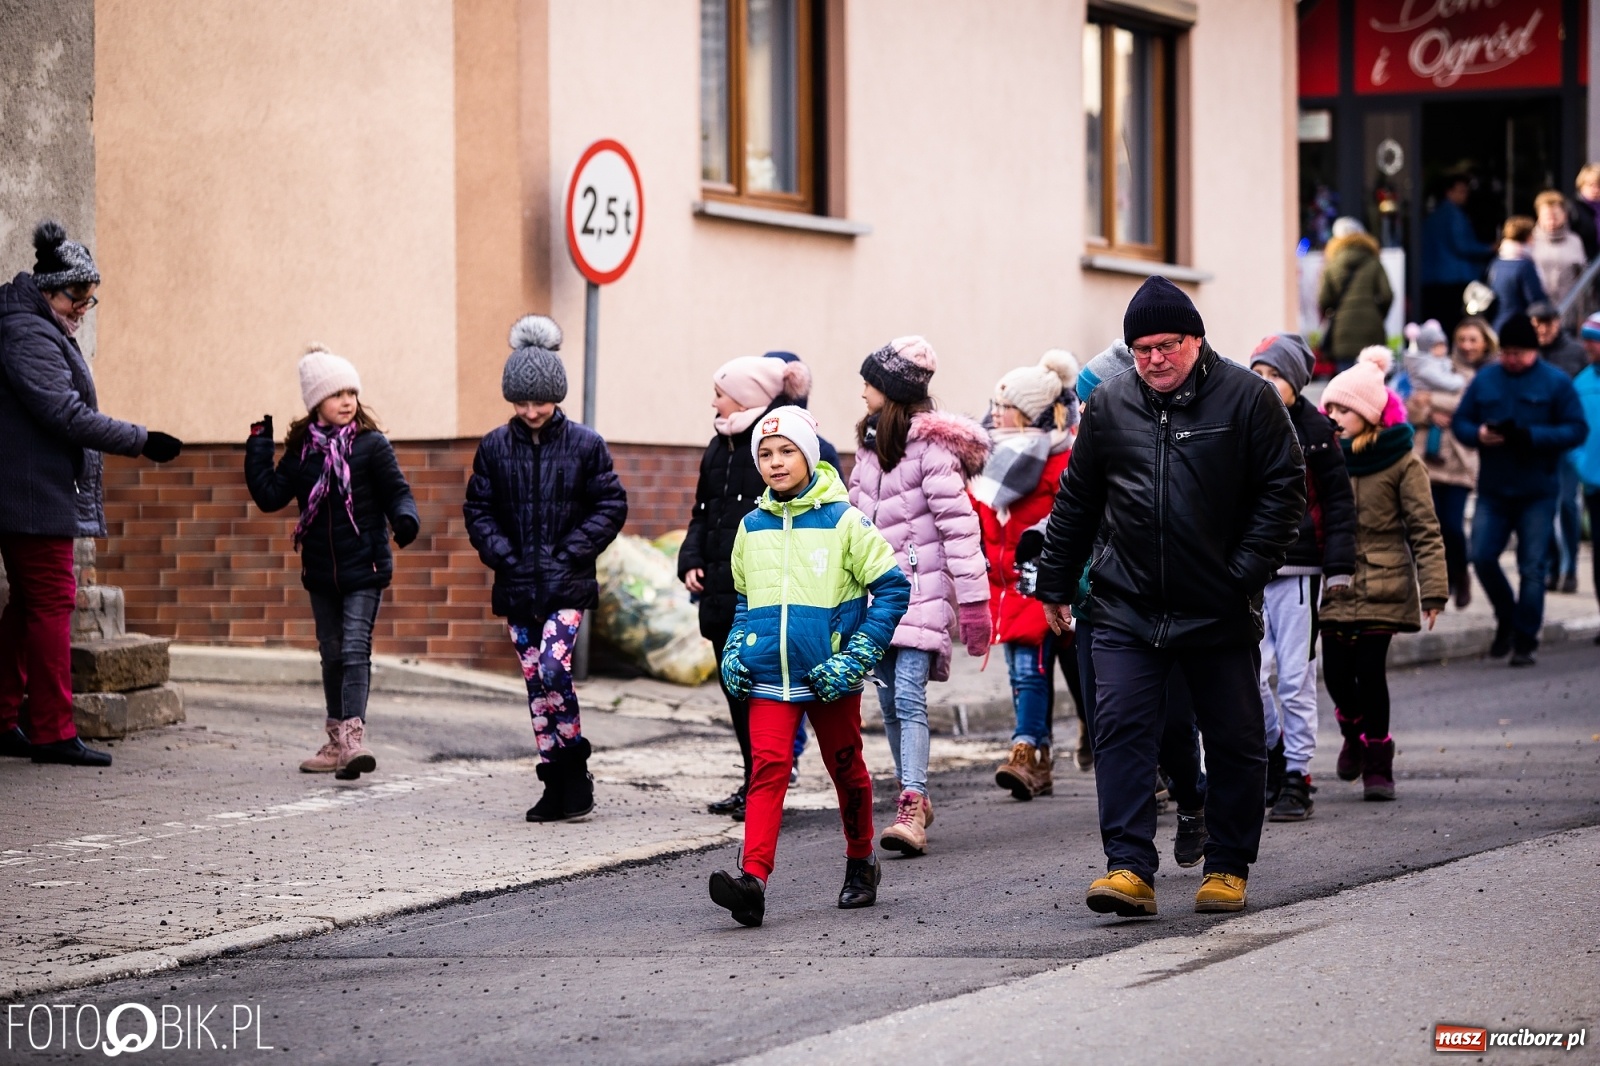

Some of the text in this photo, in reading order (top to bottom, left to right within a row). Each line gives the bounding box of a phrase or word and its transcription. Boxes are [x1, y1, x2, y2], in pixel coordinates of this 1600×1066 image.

[1370, 9, 1543, 88] i Ogród
[580, 185, 632, 242] 2,5 t
